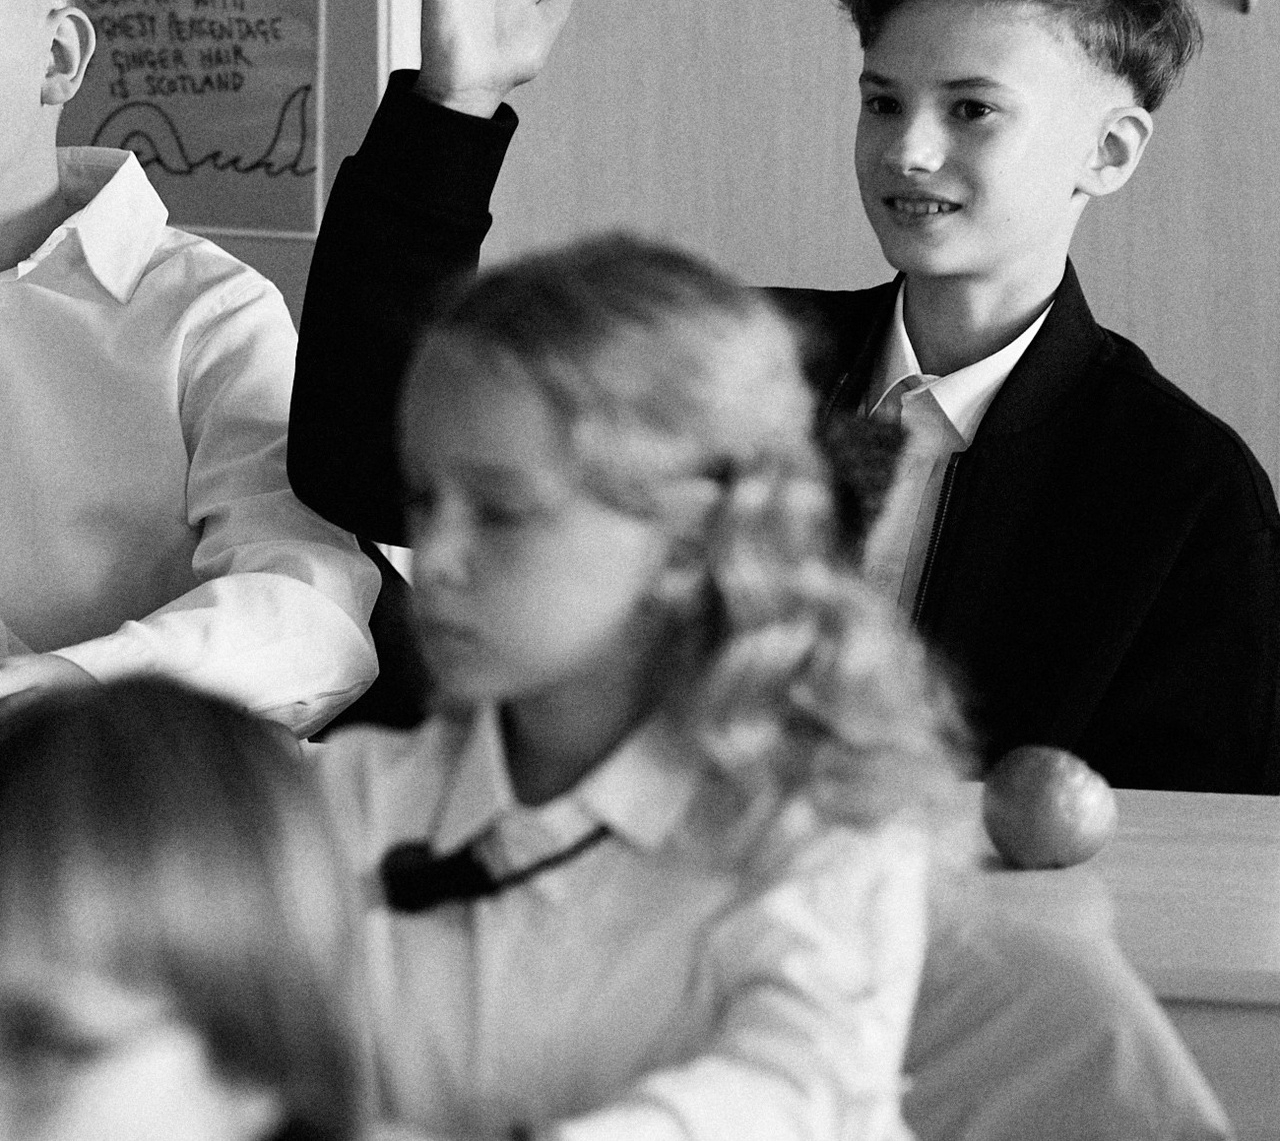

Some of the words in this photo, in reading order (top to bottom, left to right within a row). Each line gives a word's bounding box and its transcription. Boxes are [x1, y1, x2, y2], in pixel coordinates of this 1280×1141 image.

[168, 10, 283, 44] PERCENTAGE
[111, 46, 188, 77] GINGER
[199, 43, 253, 69] HAIR
[109, 76, 130, 100] IS
[144, 70, 245, 96] SCOTLAND
